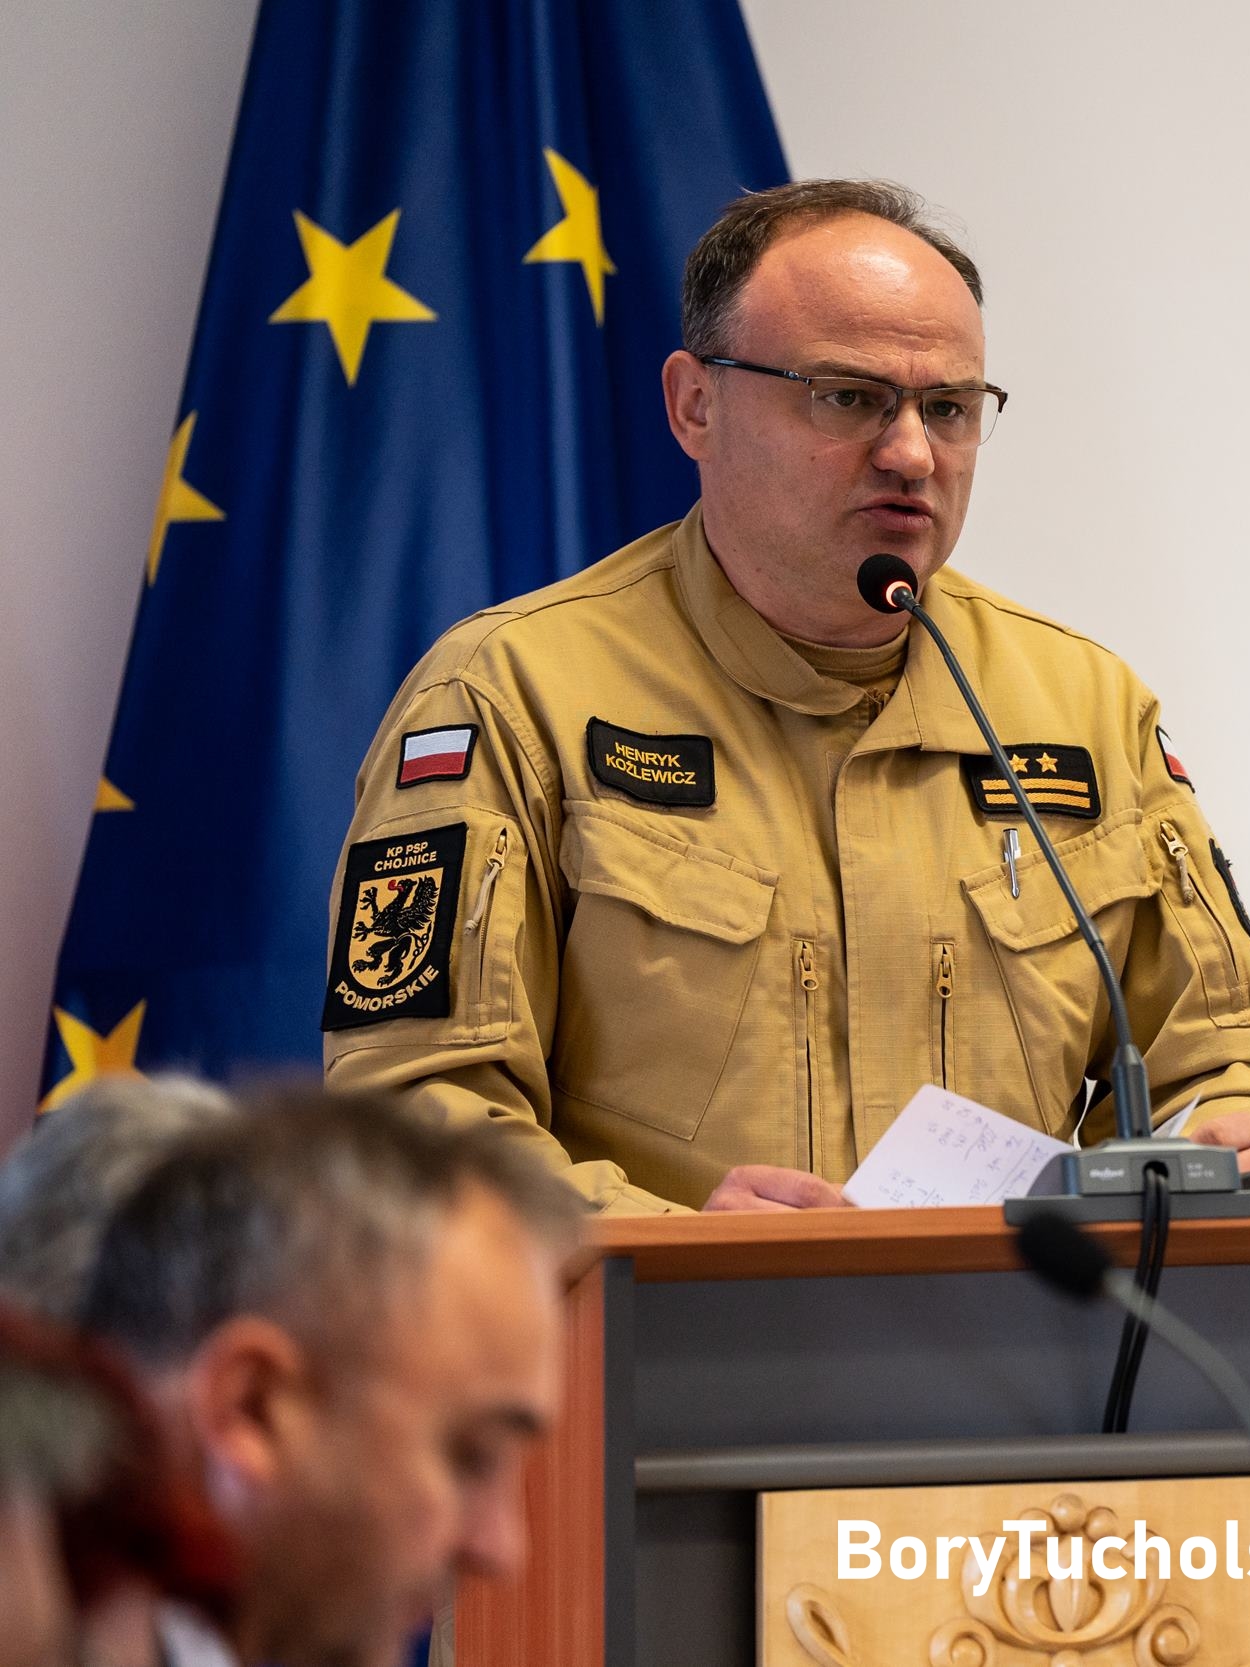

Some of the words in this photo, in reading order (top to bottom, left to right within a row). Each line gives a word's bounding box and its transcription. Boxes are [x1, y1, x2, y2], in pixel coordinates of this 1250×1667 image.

[614, 741, 681, 768] HENRYK
[374, 851, 438, 872] CHOJNICE
[386, 846, 403, 858] KP
[405, 841, 429, 854] PSP
[334, 964, 440, 1012] POMORSKIE
